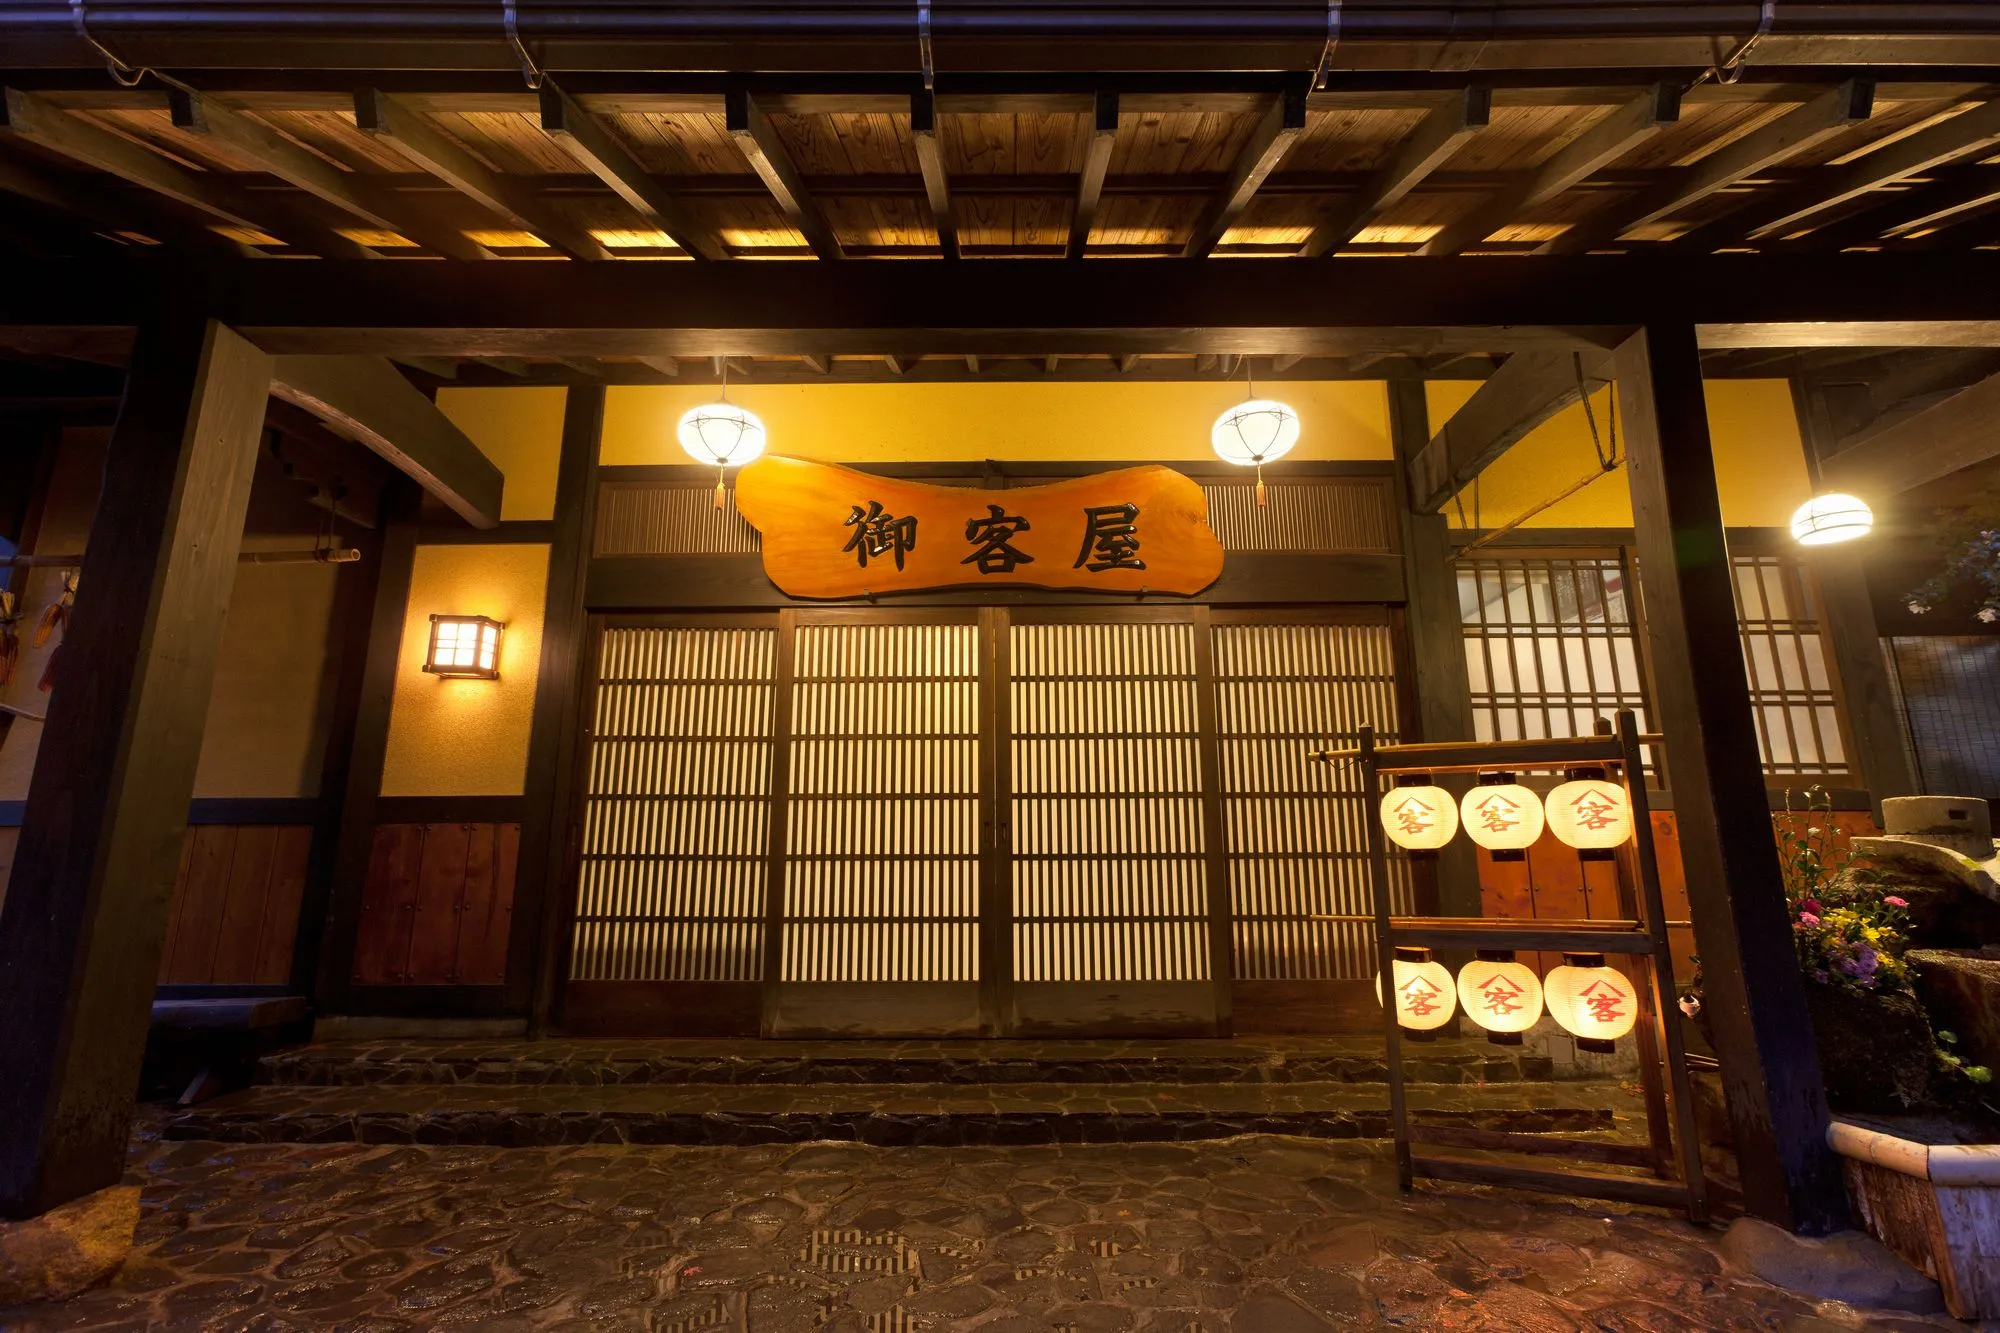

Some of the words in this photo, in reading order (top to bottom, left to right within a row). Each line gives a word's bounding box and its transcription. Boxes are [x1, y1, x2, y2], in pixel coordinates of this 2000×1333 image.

[842, 500, 1147, 575] 御客屋
[1398, 808, 1434, 834] 客
[1479, 805, 1521, 832] 客
[1576, 801, 1618, 830] 客
[1404, 989, 1441, 1016] 客
[1485, 986, 1524, 1015] 客
[1586, 993, 1626, 1022] 客
